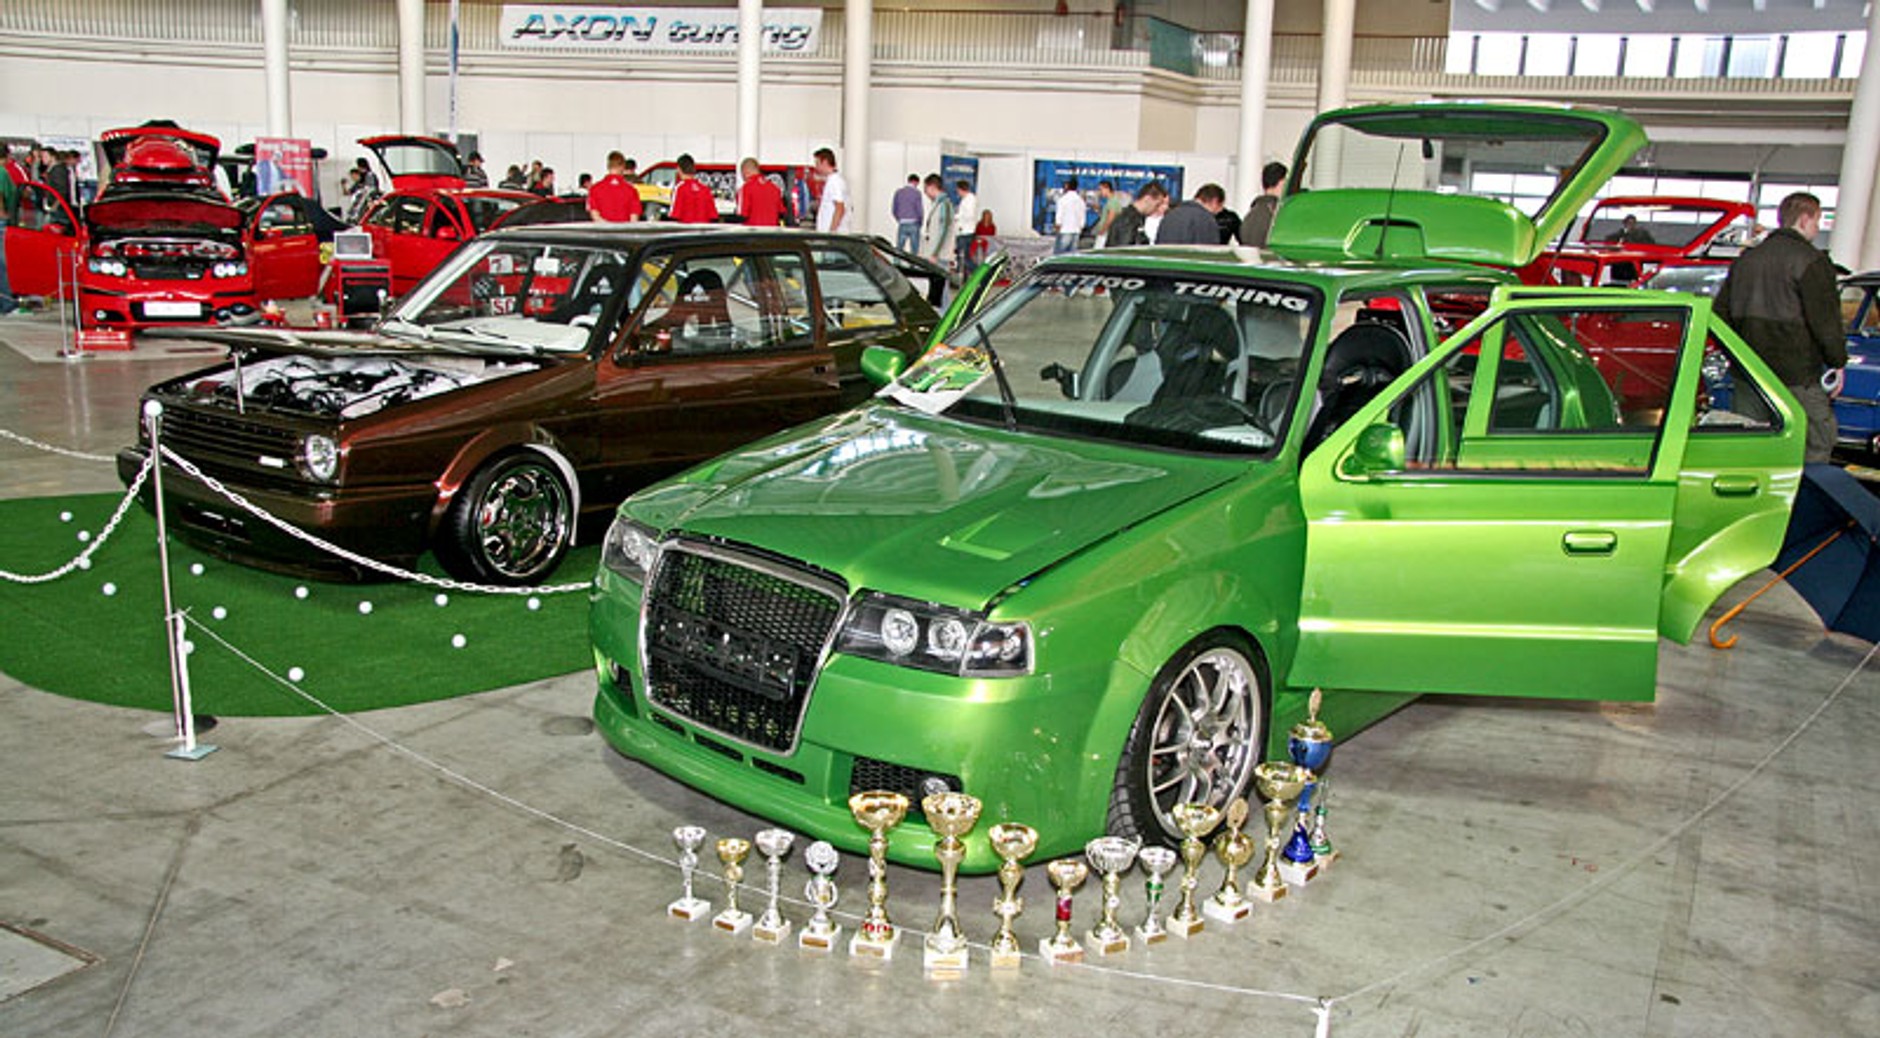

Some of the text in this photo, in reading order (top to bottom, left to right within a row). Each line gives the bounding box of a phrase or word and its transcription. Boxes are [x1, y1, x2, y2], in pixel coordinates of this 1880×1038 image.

[512, 14, 812, 50] AXON tunng
[1173, 281, 1308, 311] TUNING
